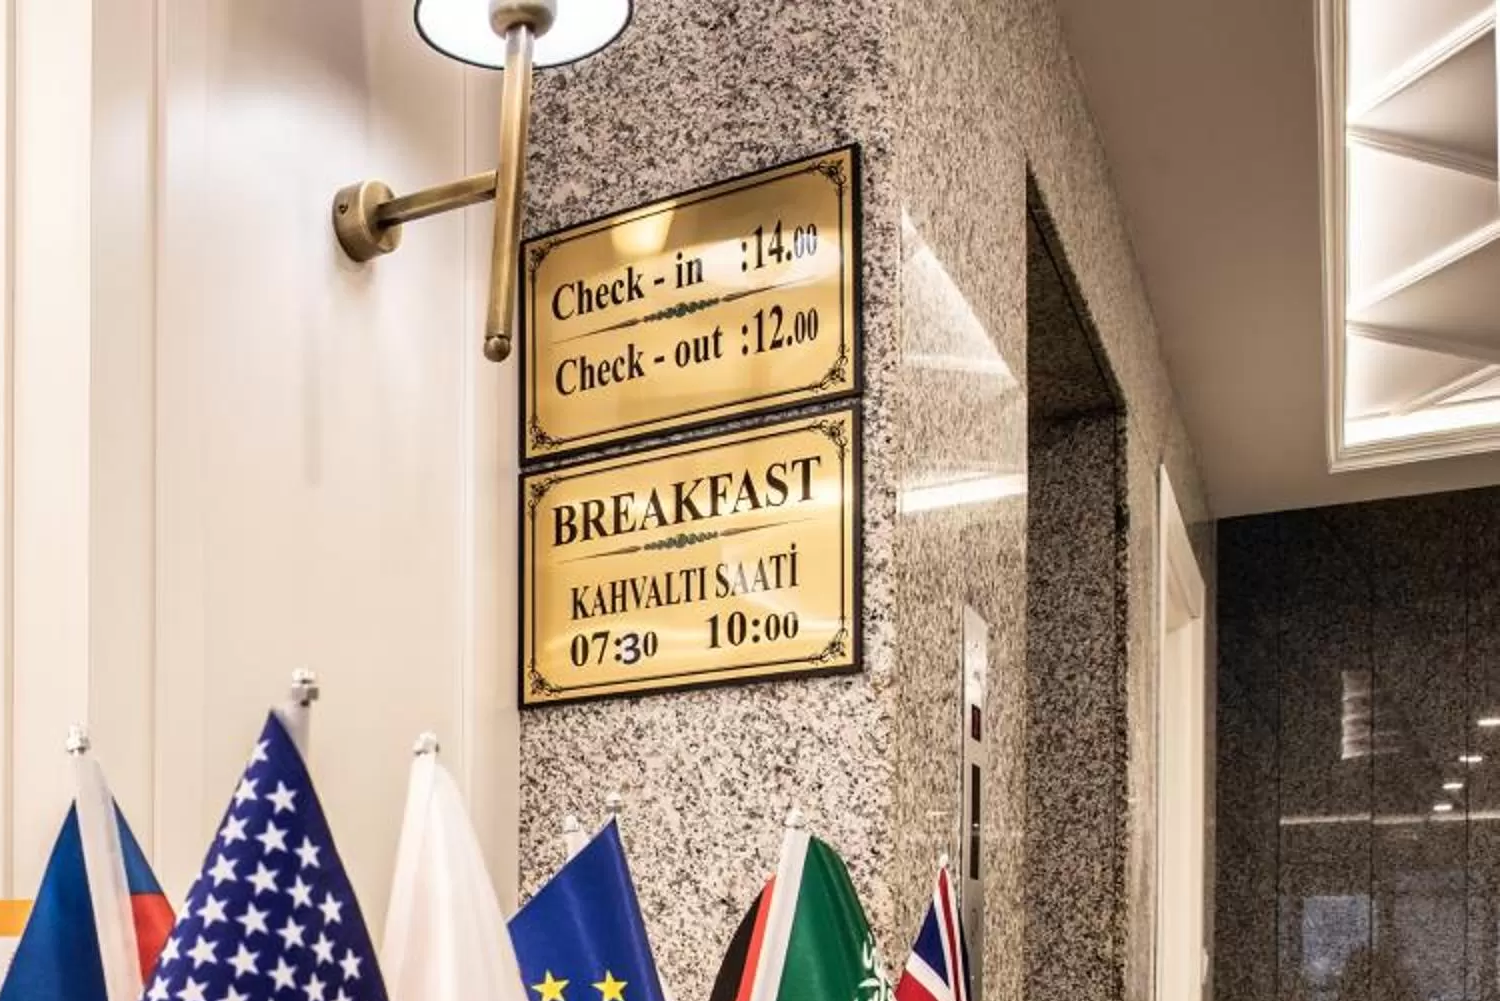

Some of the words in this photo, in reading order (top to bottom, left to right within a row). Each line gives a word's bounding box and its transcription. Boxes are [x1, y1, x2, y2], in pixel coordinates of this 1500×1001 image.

[552, 267, 644, 320] Check
[676, 252, 703, 288] in
[556, 344, 644, 395] Check
[675, 325, 723, 368] out
[552, 456, 821, 546] BREAKFAST
[571, 566, 706, 620] KAHVALTI
[715, 543, 798, 598] SAATİ
[570, 631, 658, 667] 07:30
[707, 611, 798, 648] 10:00
